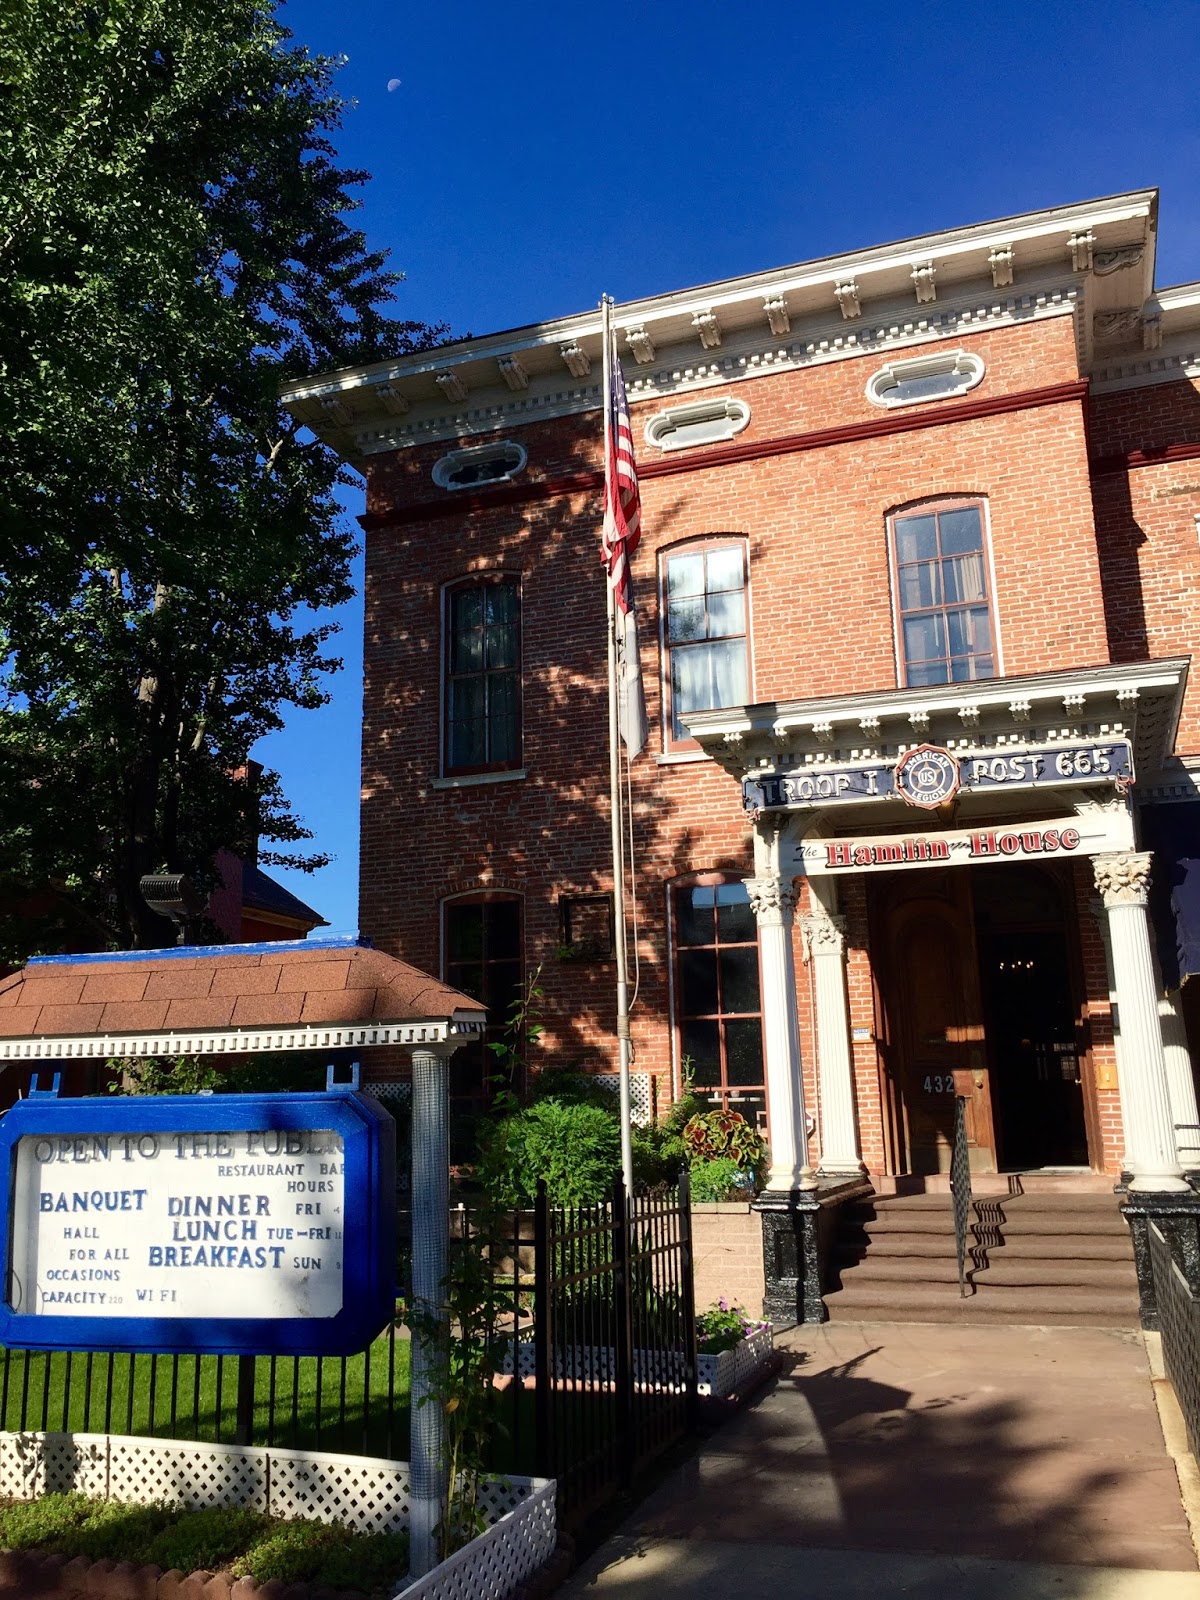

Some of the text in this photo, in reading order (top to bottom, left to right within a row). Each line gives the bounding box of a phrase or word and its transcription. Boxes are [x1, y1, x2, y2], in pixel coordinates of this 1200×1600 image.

[904, 750, 950, 772] AMERICAN
[972, 748, 1115, 783] POST 665
[921, 771, 934, 783] US
[757, 773, 851, 803] TROOP
[911, 788, 946, 802] LEGION
[795, 828, 1081, 868] The Hamlin House
[923, 1075, 955, 1093] 432
[34, 1135, 112, 1163] OPEN
[119, 1134, 159, 1161] TO
[172, 1131, 232, 1158] THE
[217, 1163, 305, 1177] RESTAURANT
[287, 1180, 334, 1193] HOURS
[39, 1188, 148, 1213] BANQUET
[167, 1194, 272, 1217] DINNER
[295, 1202, 322, 1216] FRI
[63, 1226, 100, 1239] HALL
[172, 1219, 258, 1242] LUNCH
[69, 1248, 130, 1261] FOR ALL
[148, 1244, 286, 1268] BREAKFAST
[293, 1256, 322, 1270] SUN
[46, 1269, 121, 1282] OCCASIONS
[42, 1291, 123, 1304] CAPACITY 220
